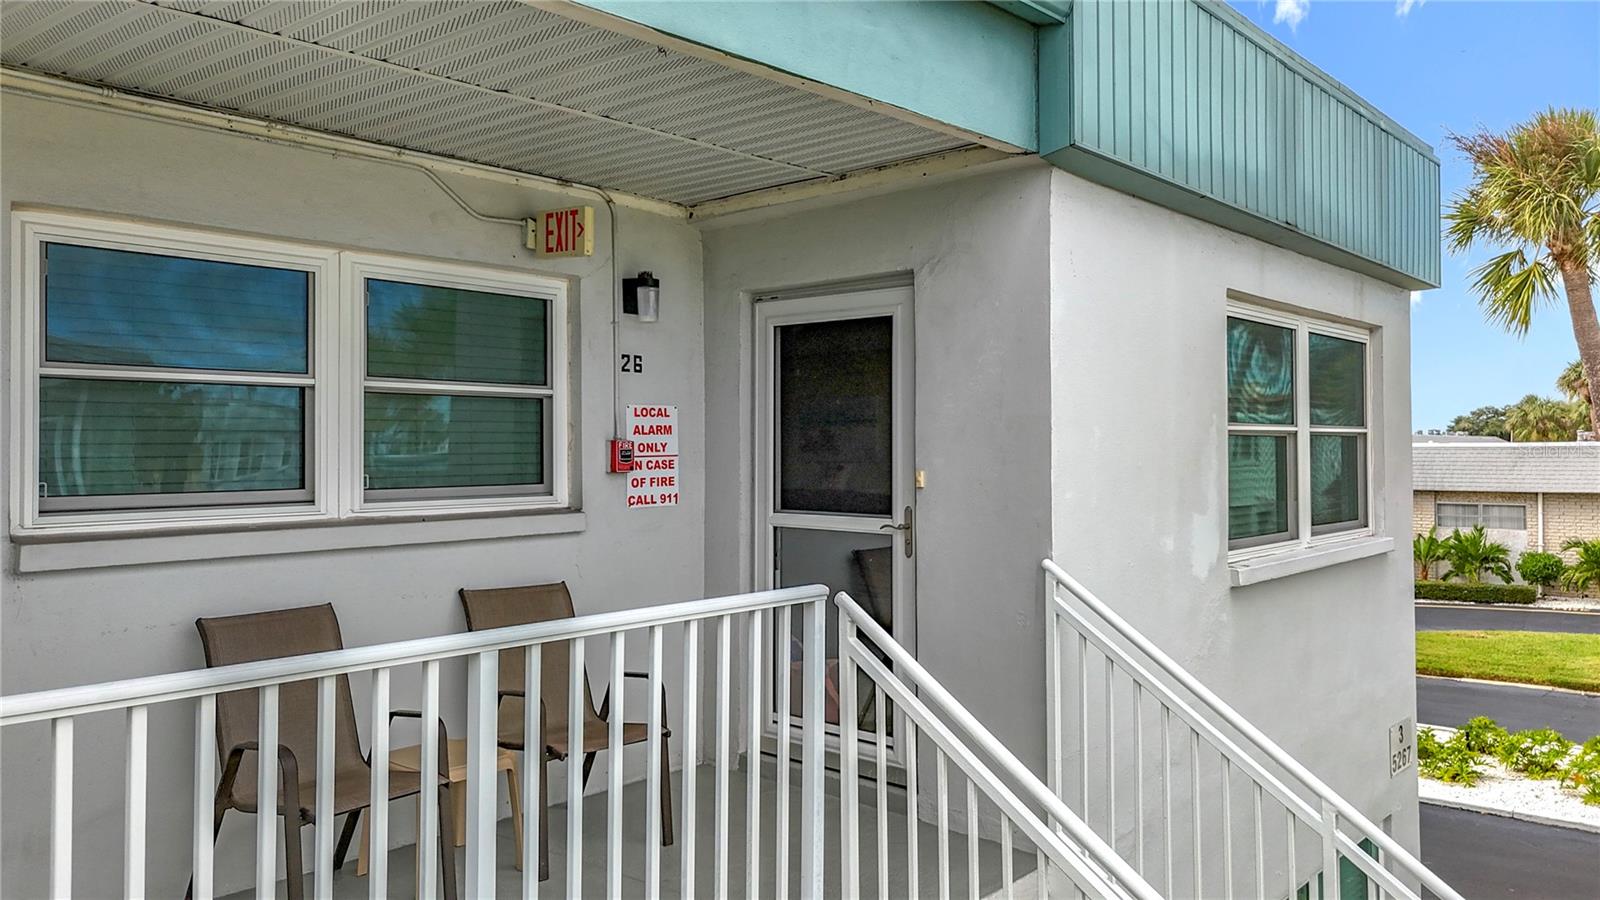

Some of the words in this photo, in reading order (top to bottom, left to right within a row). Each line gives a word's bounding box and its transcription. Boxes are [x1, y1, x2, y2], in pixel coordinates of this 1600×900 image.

[545, 209, 579, 253] EXIT
[621, 354, 643, 373] 26
[633, 407, 670, 418] LOCAL
[633, 425, 673, 436] ALARM
[618, 441, 633, 449] FIRE
[637, 442, 668, 453] ONLY
[634, 460, 643, 470] N
[646, 459, 675, 470] CASE
[631, 477, 646, 488] OF
[649, 476, 675, 487] FIRE
[627, 494, 657, 506] CALL
[660, 493, 679, 504] 911
[1398, 725, 1404, 743] 3
[1392, 745, 1411, 773] 5267
